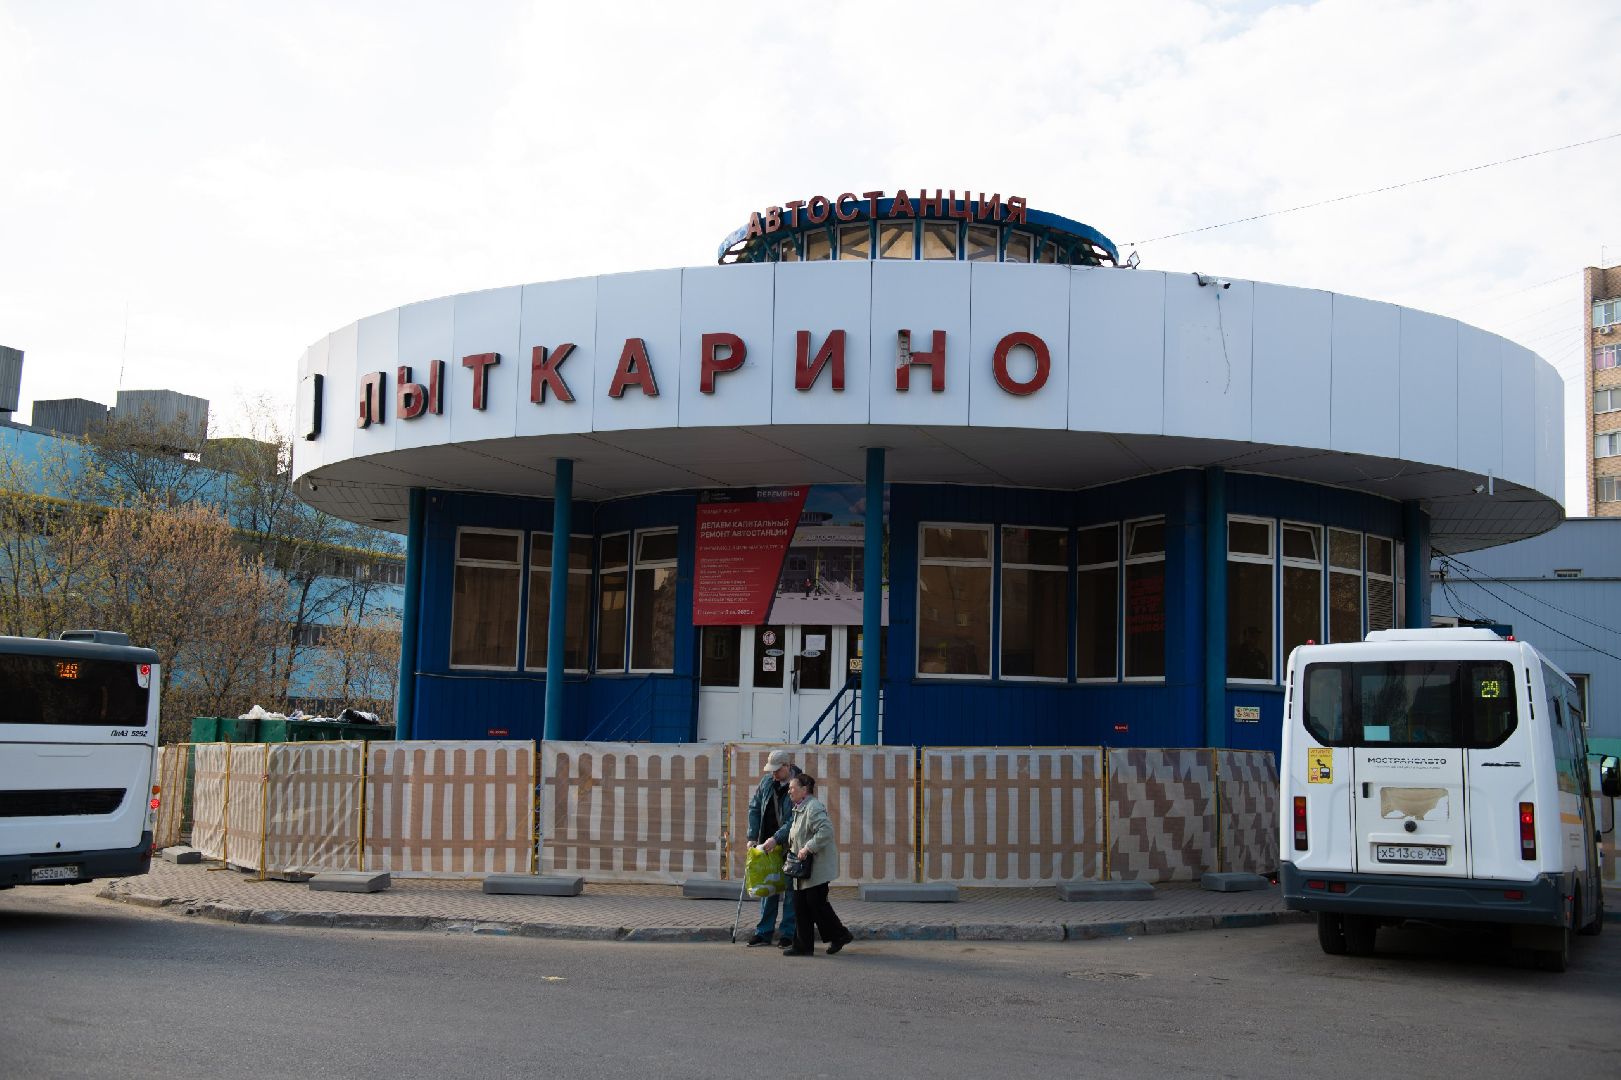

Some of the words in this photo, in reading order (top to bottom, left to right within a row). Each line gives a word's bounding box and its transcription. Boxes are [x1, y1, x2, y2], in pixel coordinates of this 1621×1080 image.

[749, 189, 1027, 237] АВТОСТАНЦИЯ
[357, 329, 1051, 429] ЛЫТКАРИНО
[756, 490, 800, 498] ПЕРЕМЕНЫ
[701, 521, 732, 530] ДЕЛАЕМ
[732, 518, 789, 528] КАПИТАЛЬНЫЙ
[700, 530, 731, 539] РЕМОНТ
[731, 528, 788, 537] АВТОСТАНЦИИ
[1481, 680, 1500, 698] 29
[130, 730, 148, 738] 5292
